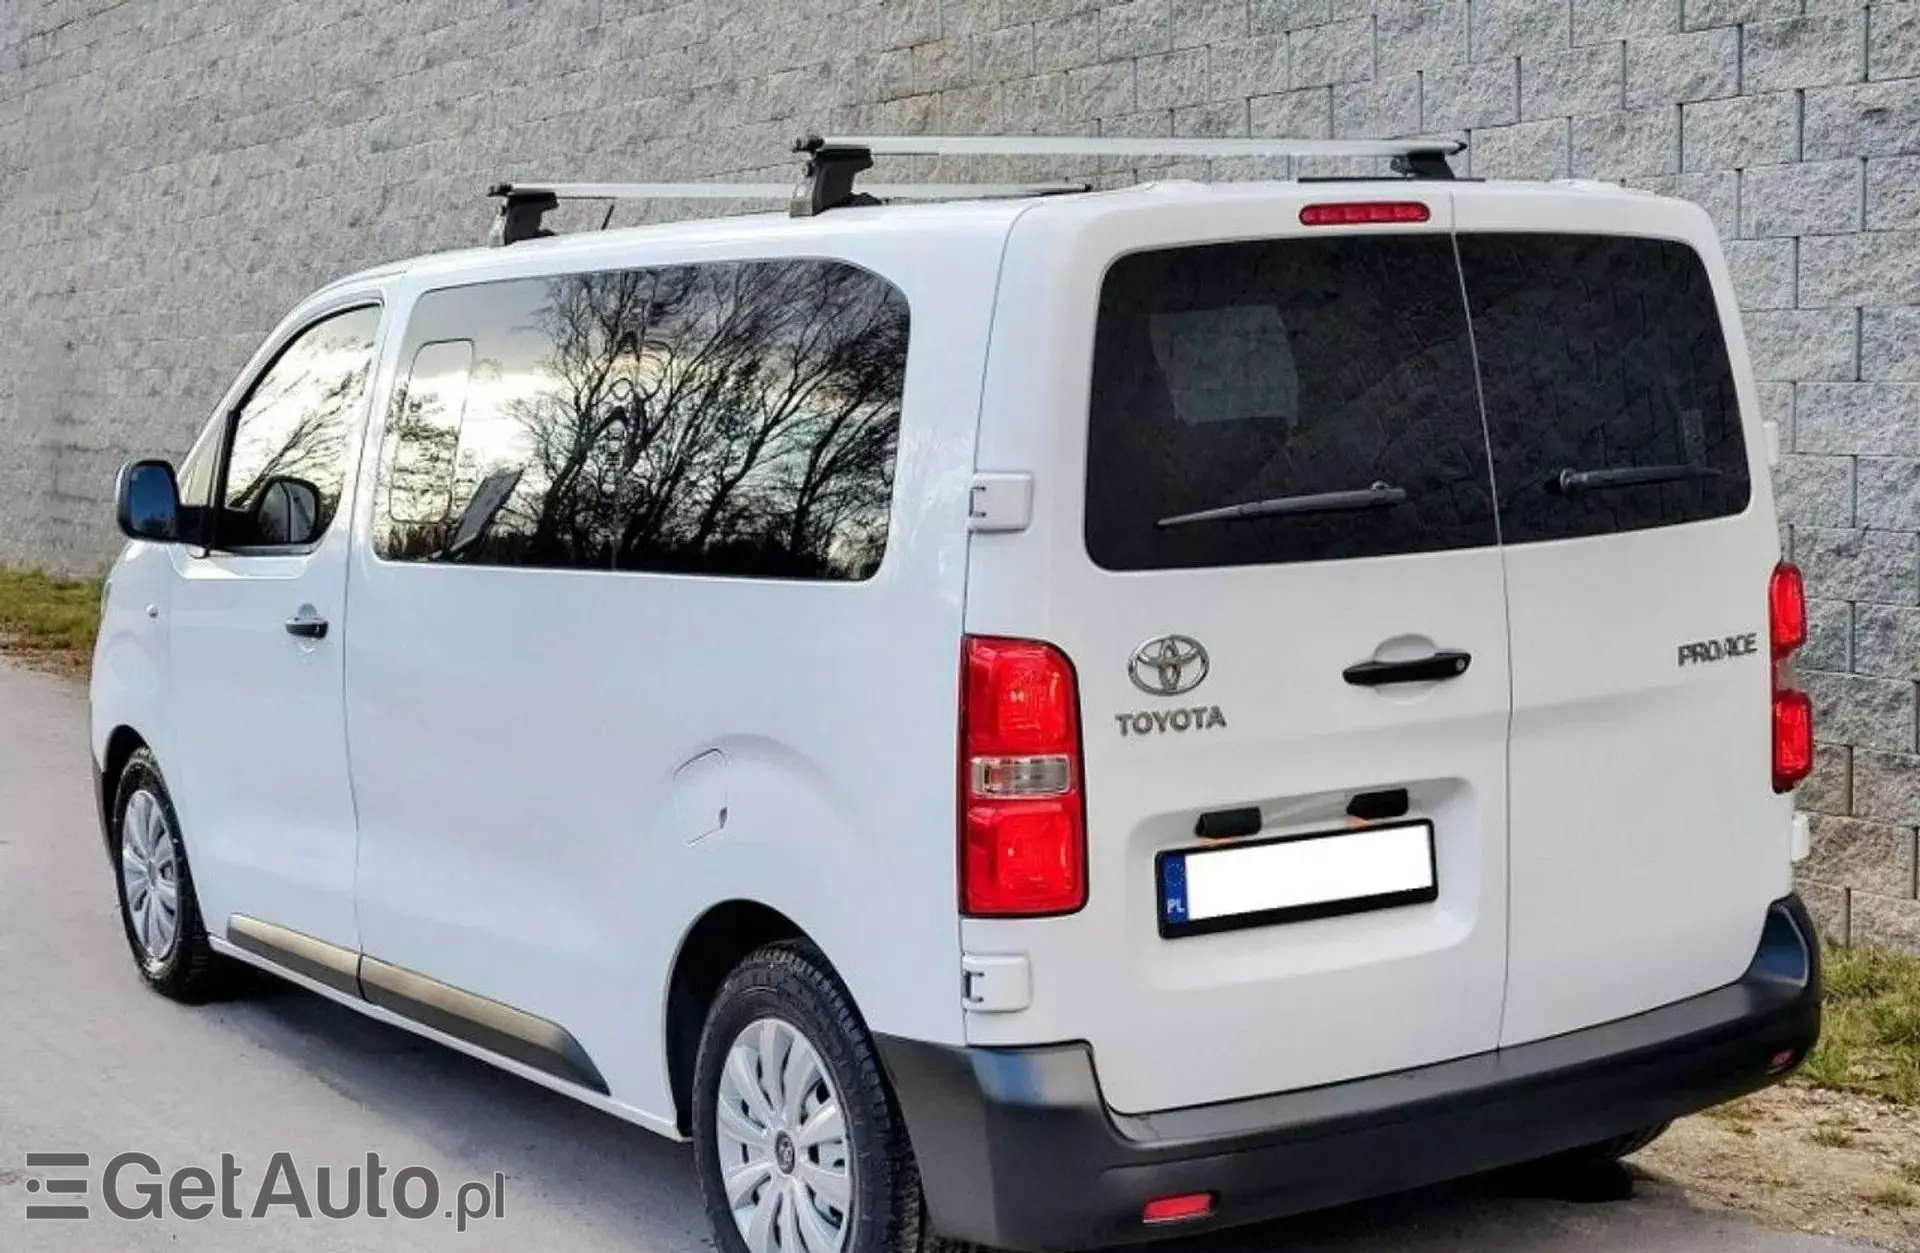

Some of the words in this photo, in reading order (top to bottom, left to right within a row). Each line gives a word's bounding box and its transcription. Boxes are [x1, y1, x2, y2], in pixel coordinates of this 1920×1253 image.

[1678, 632, 1758, 667] PROACE
[1115, 705, 1227, 736] TOYOTA
[1167, 899, 1185, 913] PL
